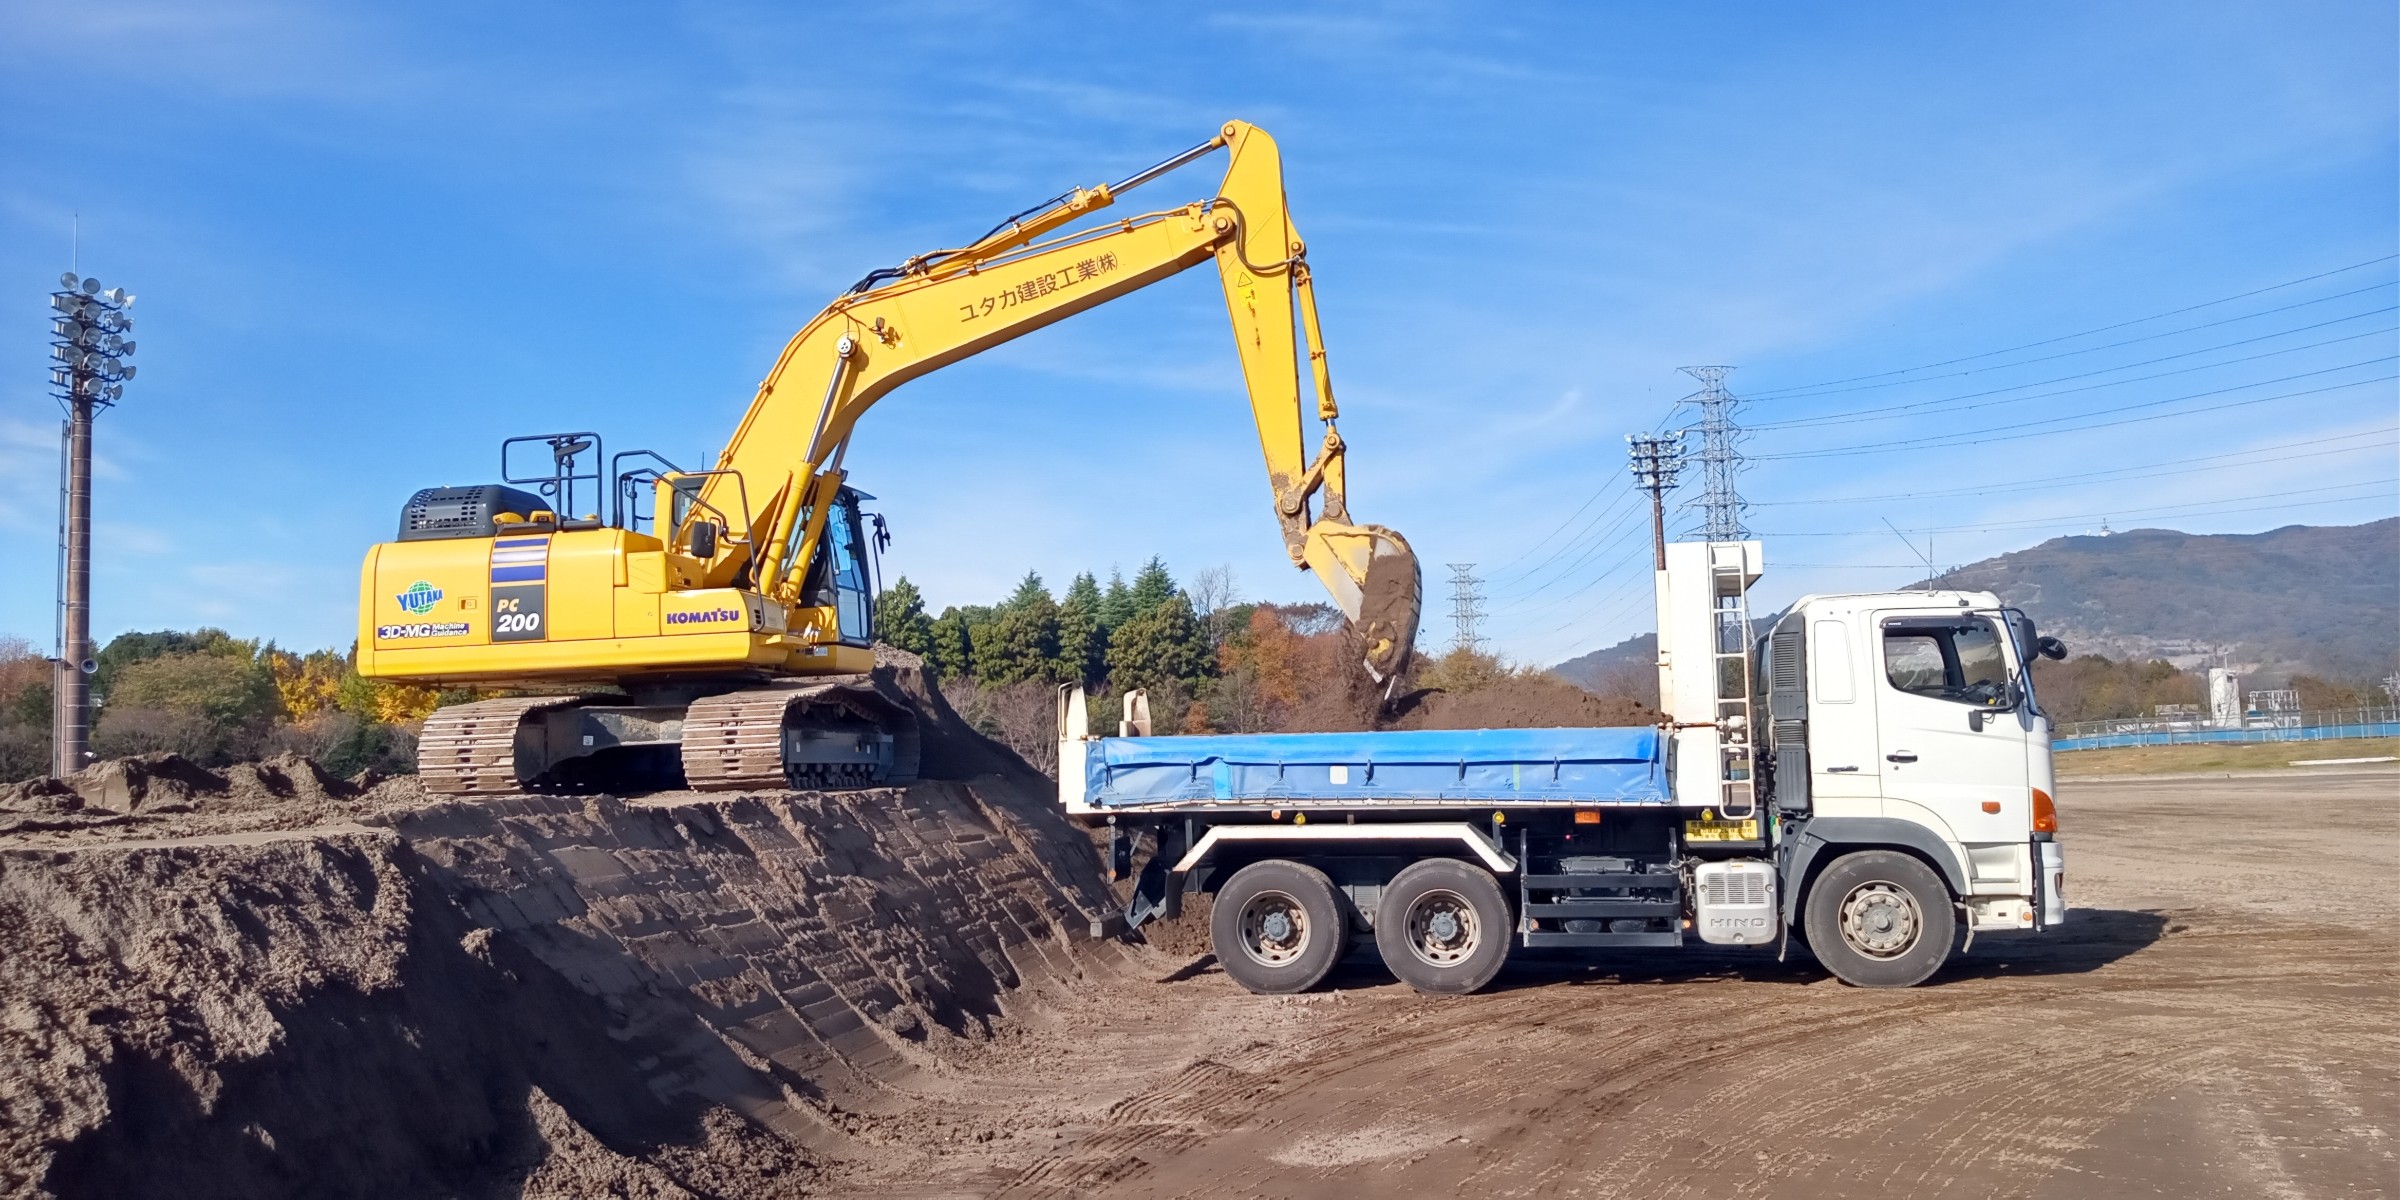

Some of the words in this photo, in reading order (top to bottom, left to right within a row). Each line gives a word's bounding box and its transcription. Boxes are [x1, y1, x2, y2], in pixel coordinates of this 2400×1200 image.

[396, 588, 443, 611] YUTAKA
[496, 598, 520, 613] PC
[496, 612, 540, 633] 200
[666, 608, 739, 624] KOMATSU
[379, 623, 431, 640] 3D-MG
[431, 622, 466, 631] Machine
[431, 628, 468, 637] Guidance
[1710, 917, 1767, 928] HINO
